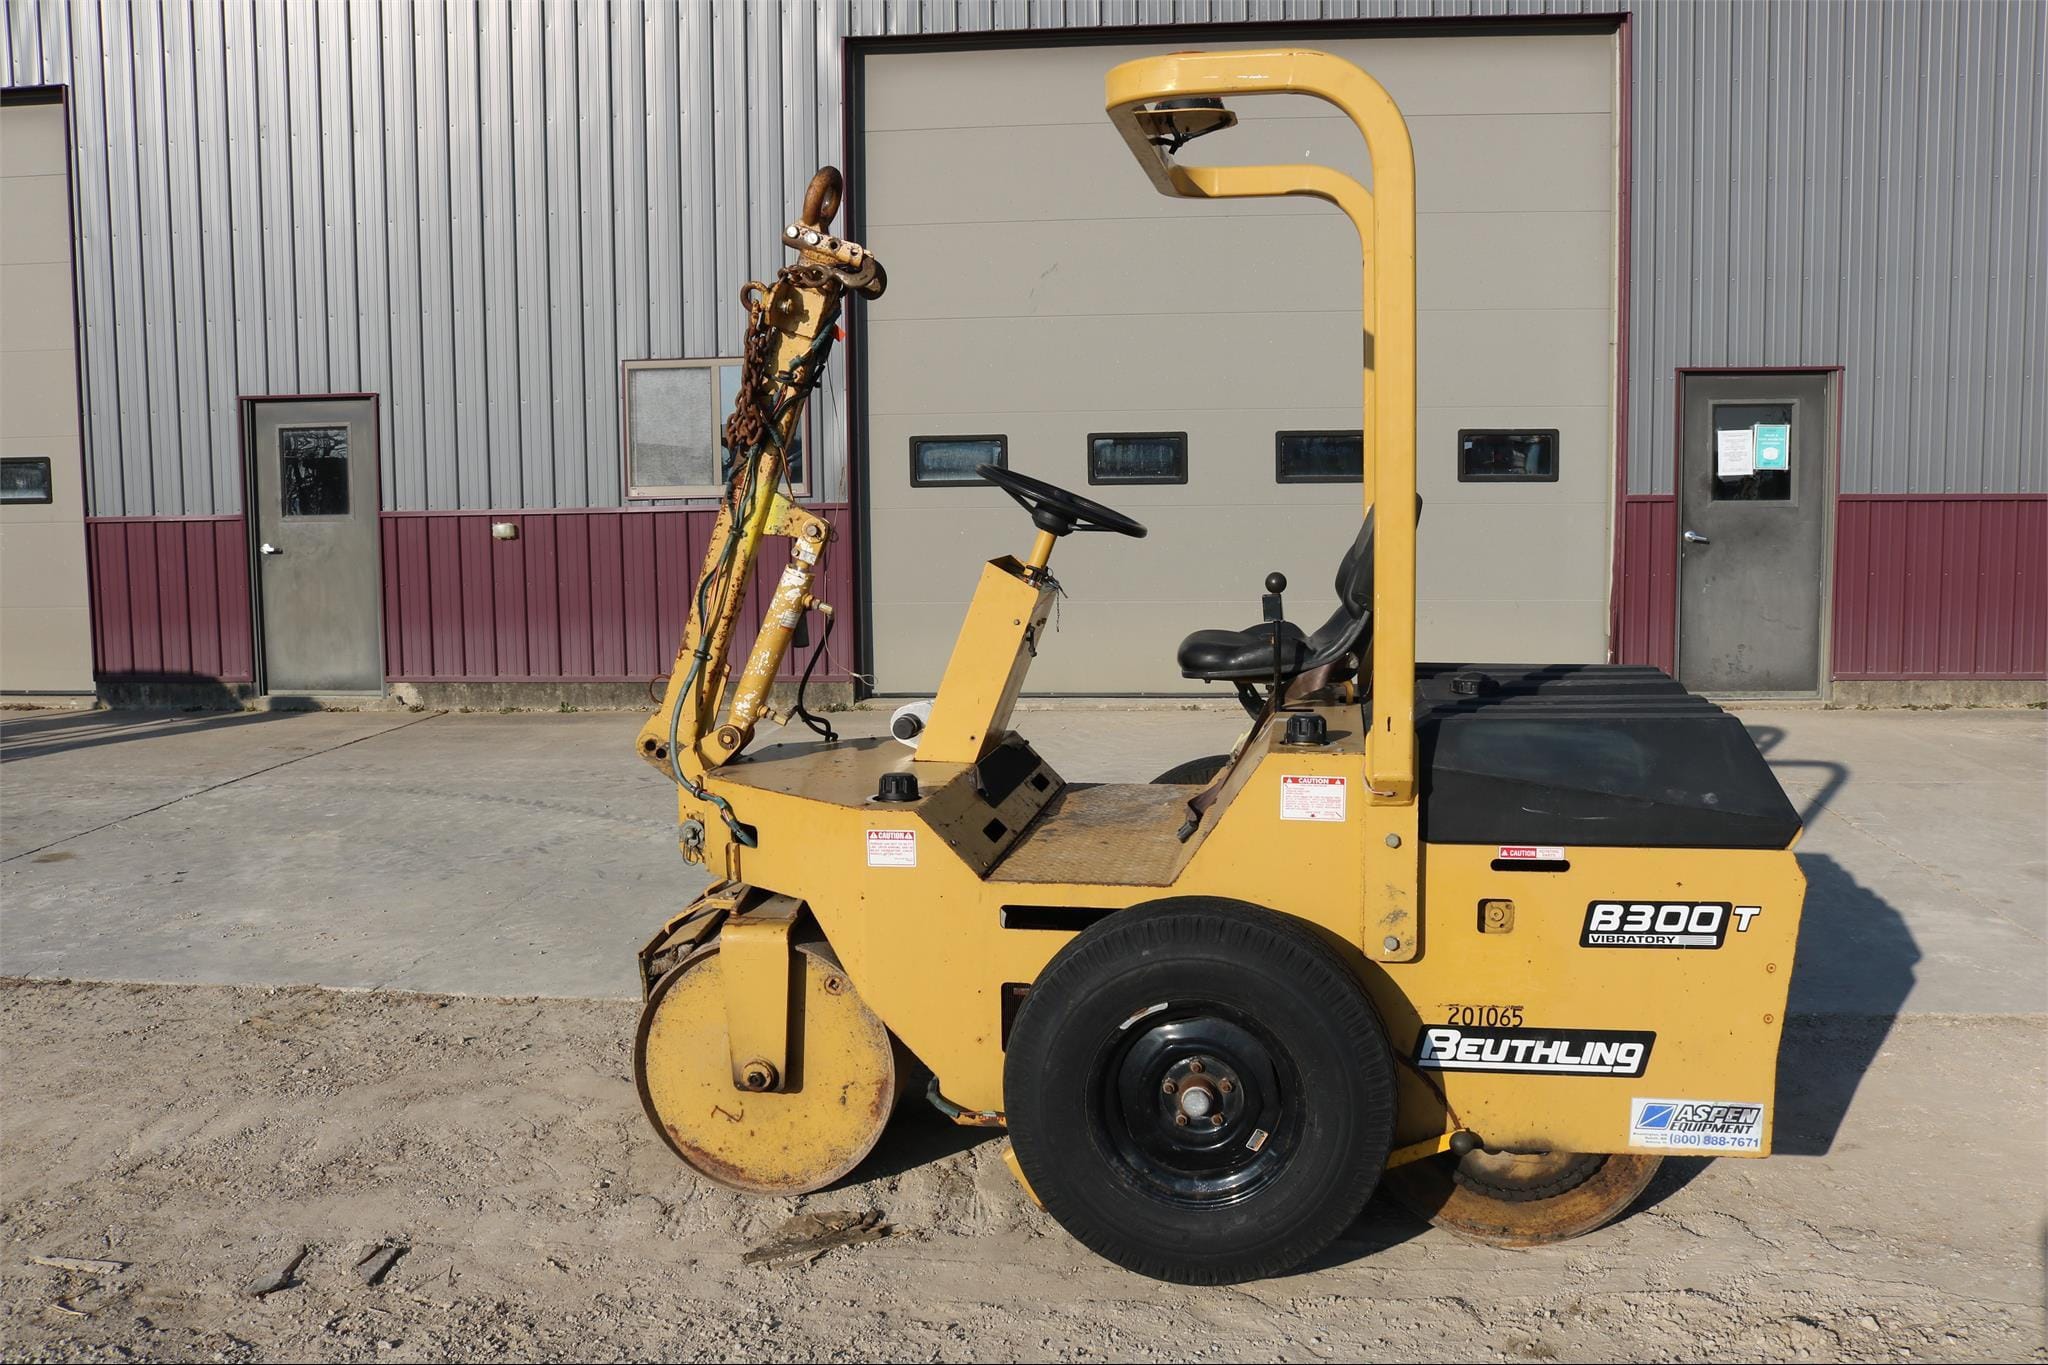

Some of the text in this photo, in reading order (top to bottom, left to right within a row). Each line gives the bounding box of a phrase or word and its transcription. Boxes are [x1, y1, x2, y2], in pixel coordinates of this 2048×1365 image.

[1298, 777, 1329, 785] CAUTION
[877, 831, 905, 840] CAUTION
[1509, 849, 1536, 857] CAUTION
[1589, 904, 1724, 933] B300
[1591, 935, 1676, 944] VIBRATORY
[1447, 1006, 1523, 1027] 201065
[1674, 1104, 1761, 1125] ASPEN
[1669, 1121, 1754, 1134] EQUIPMENT
[1669, 1133, 1701, 1147] (800)
[1703, 1135, 1759, 1148] 888-7671
